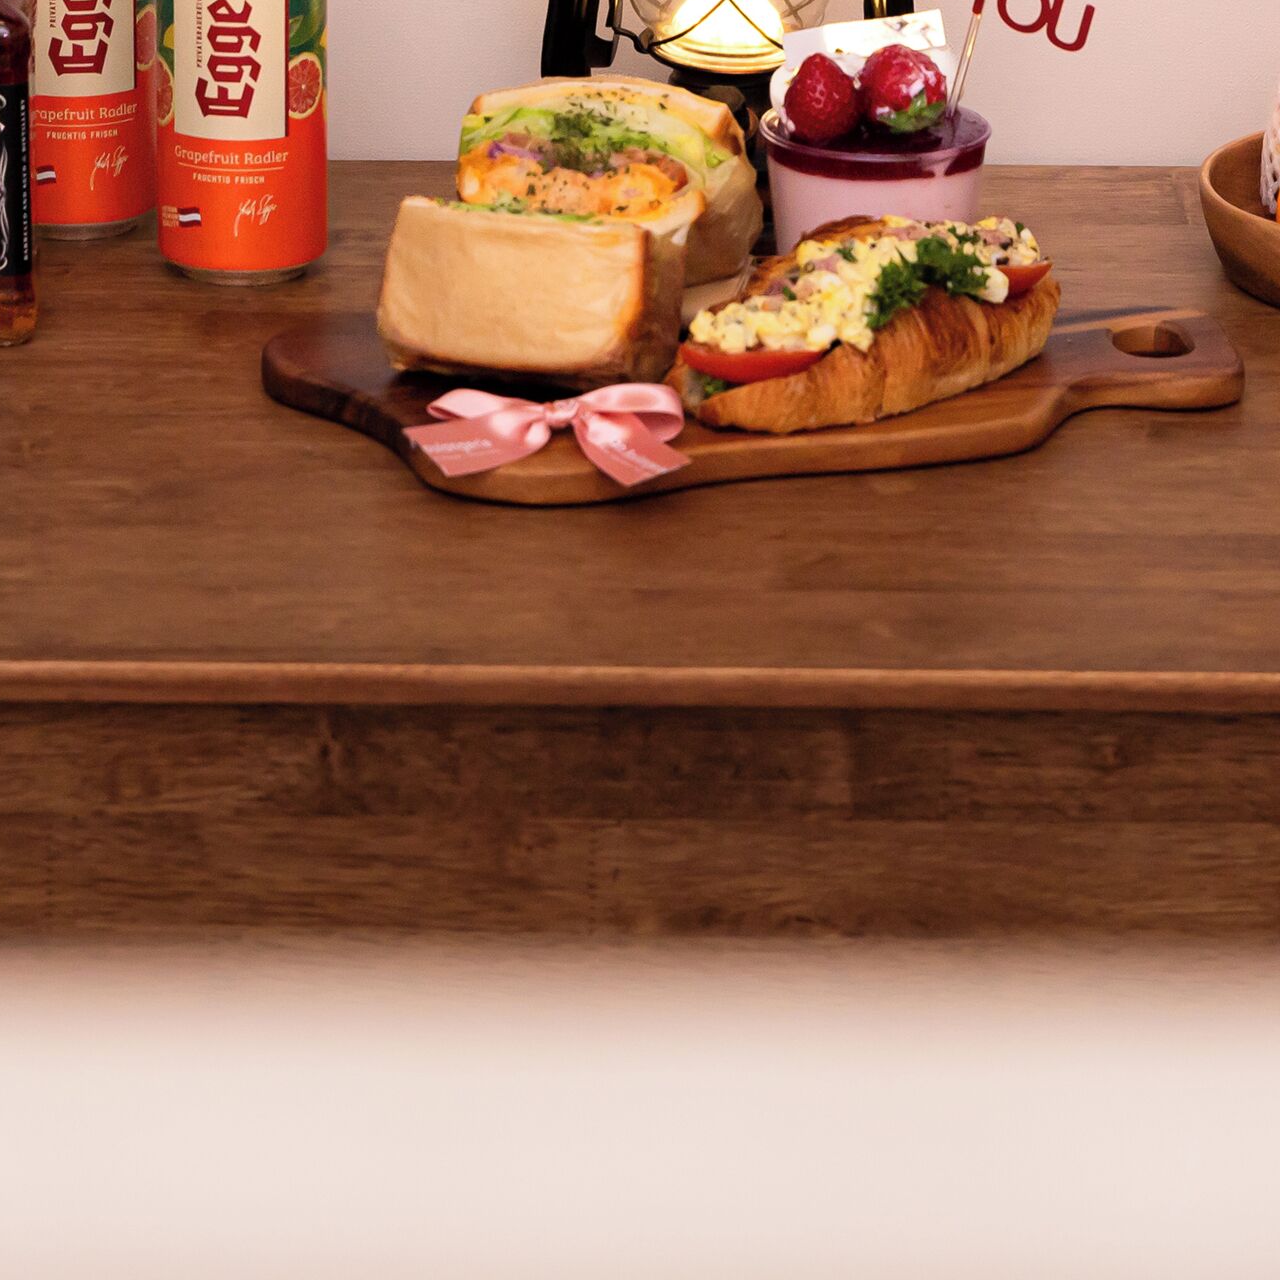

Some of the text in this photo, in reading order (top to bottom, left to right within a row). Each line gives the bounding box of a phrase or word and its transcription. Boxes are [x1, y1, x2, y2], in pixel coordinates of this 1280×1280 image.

[99, 103, 138, 119] Radler
[46, 128, 118, 140] FRUCHTIG FRISCH
[174, 145, 288, 165] Grapefruit Radler
[192, 172, 265, 185] FRUCHTIG FRISCH
